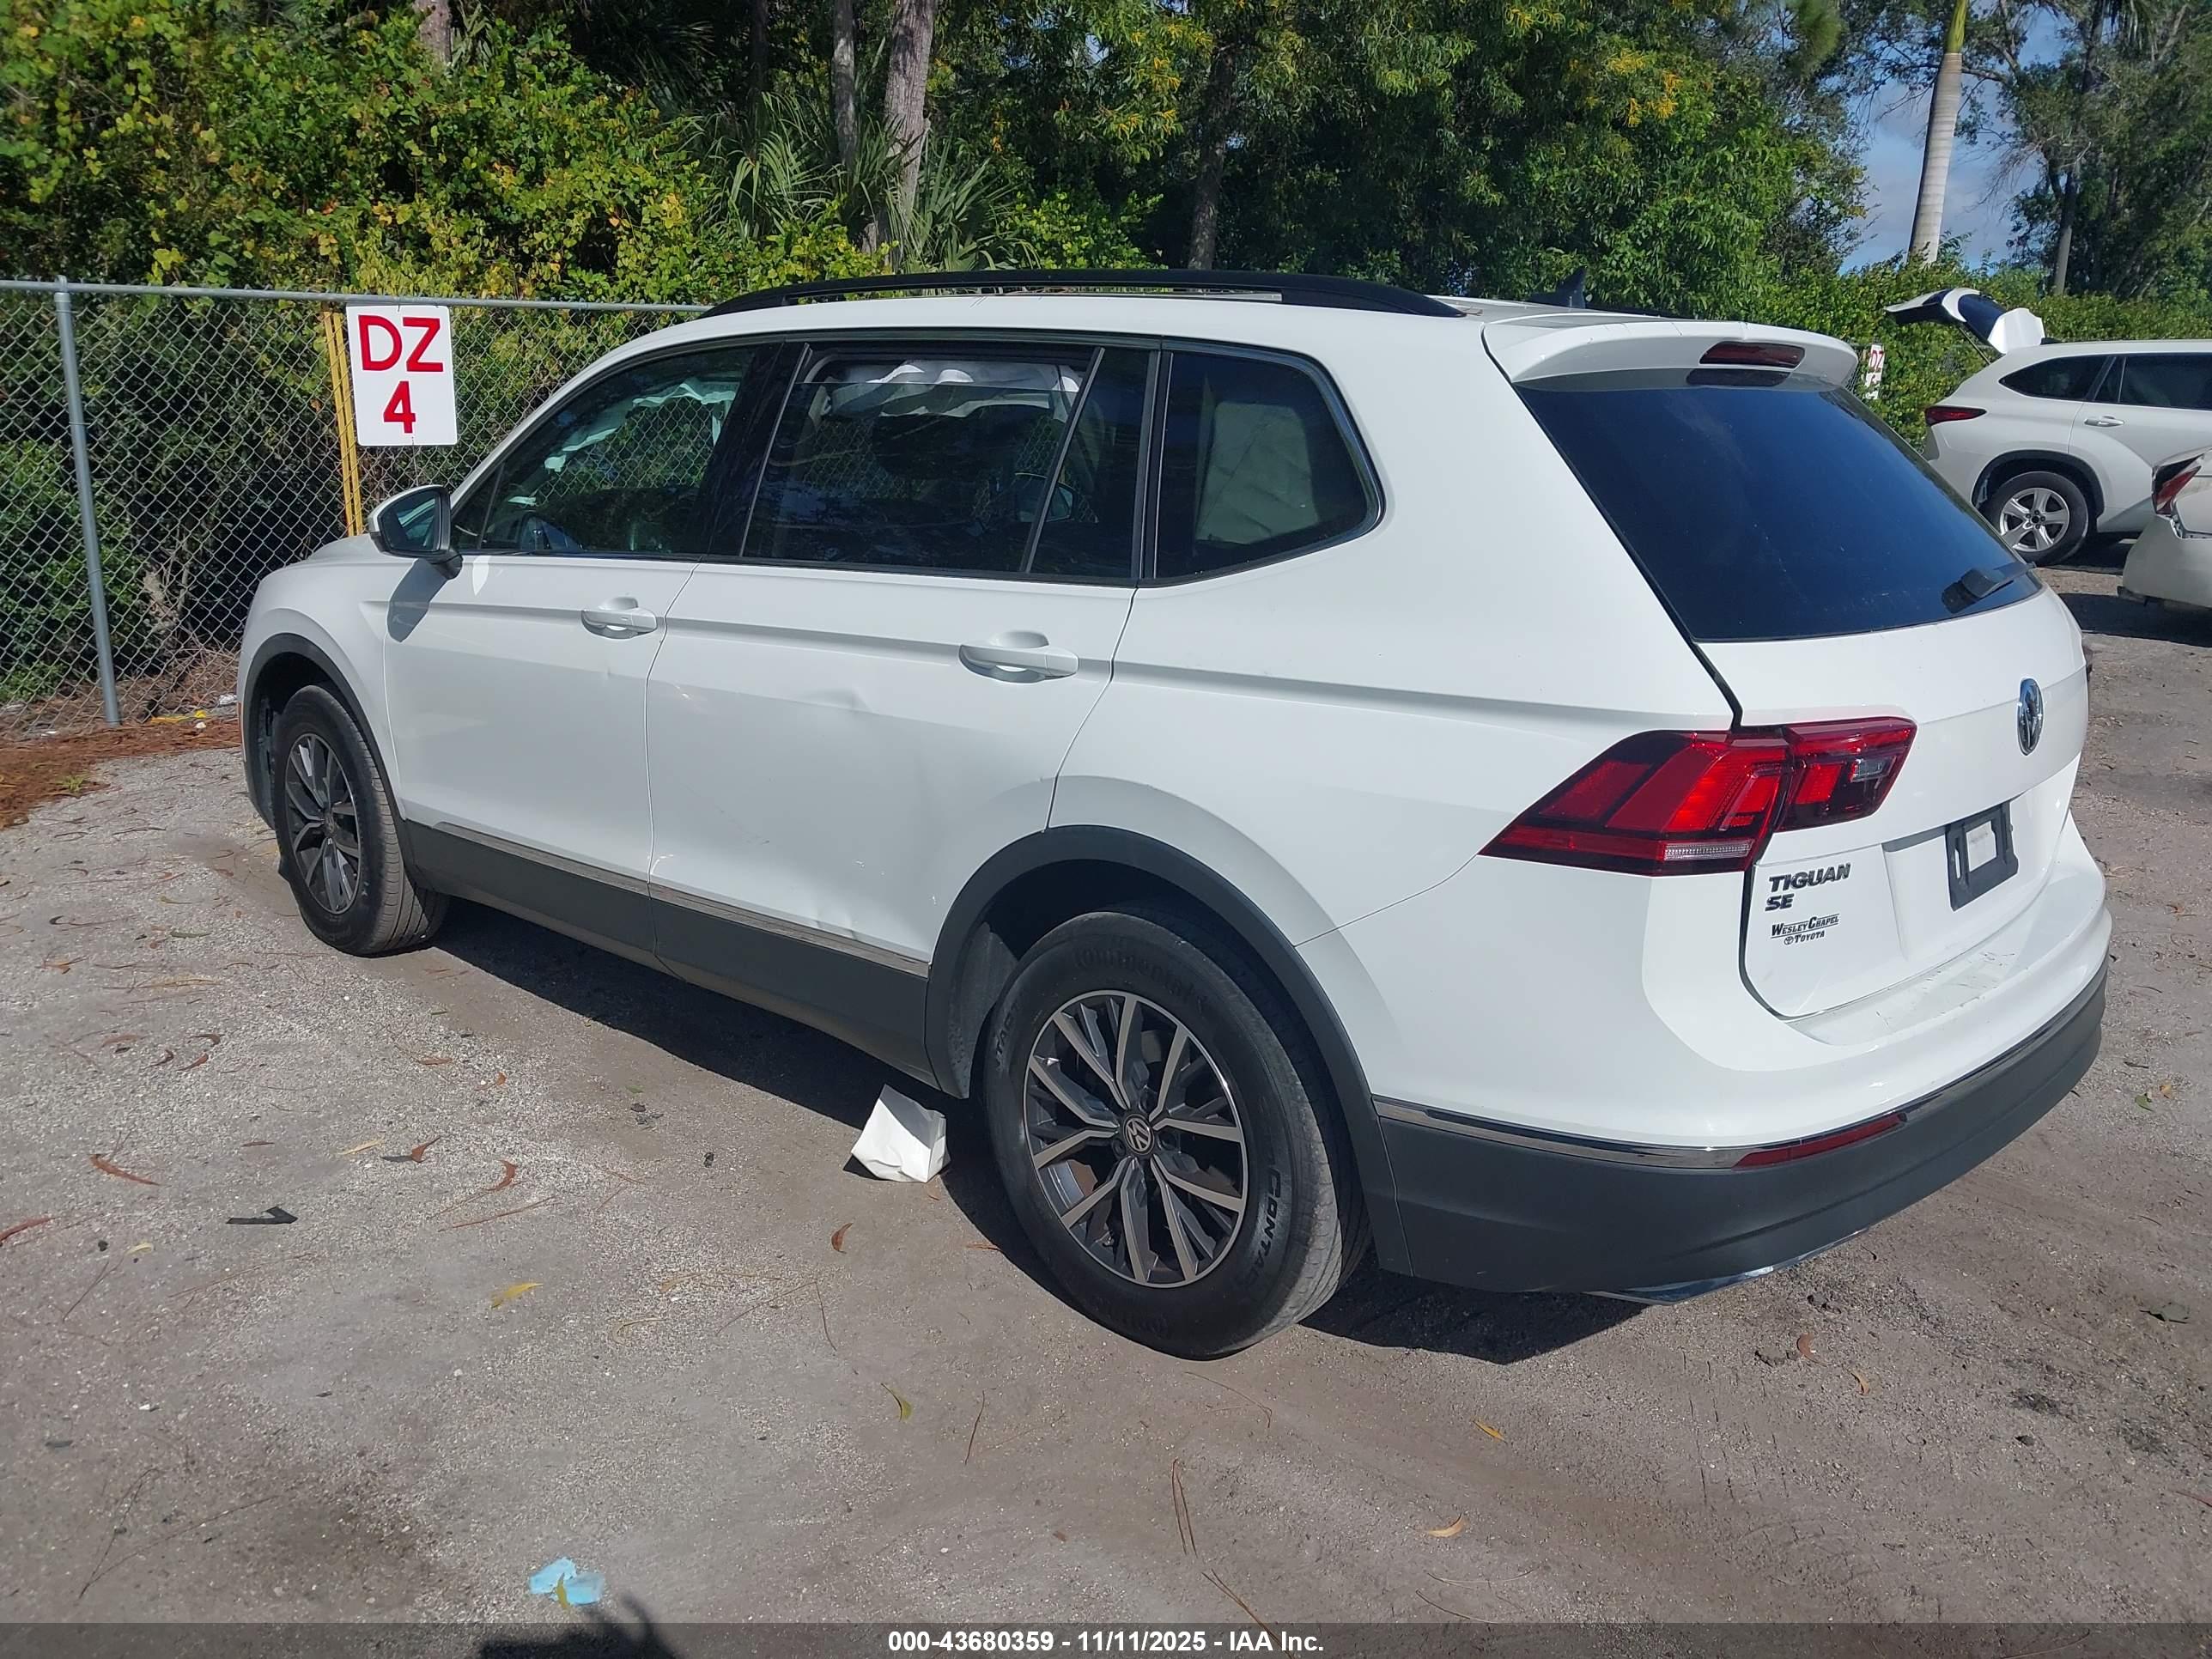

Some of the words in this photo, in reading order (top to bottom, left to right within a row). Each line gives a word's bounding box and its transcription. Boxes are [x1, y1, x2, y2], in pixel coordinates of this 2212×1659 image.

[358, 314, 444, 373] DZ
[383, 380, 416, 434] 4
[1769, 863, 1850, 893] TIGUAN
[1765, 893, 1795, 911] SE
[1795, 930, 1826, 944] TOYOTA
